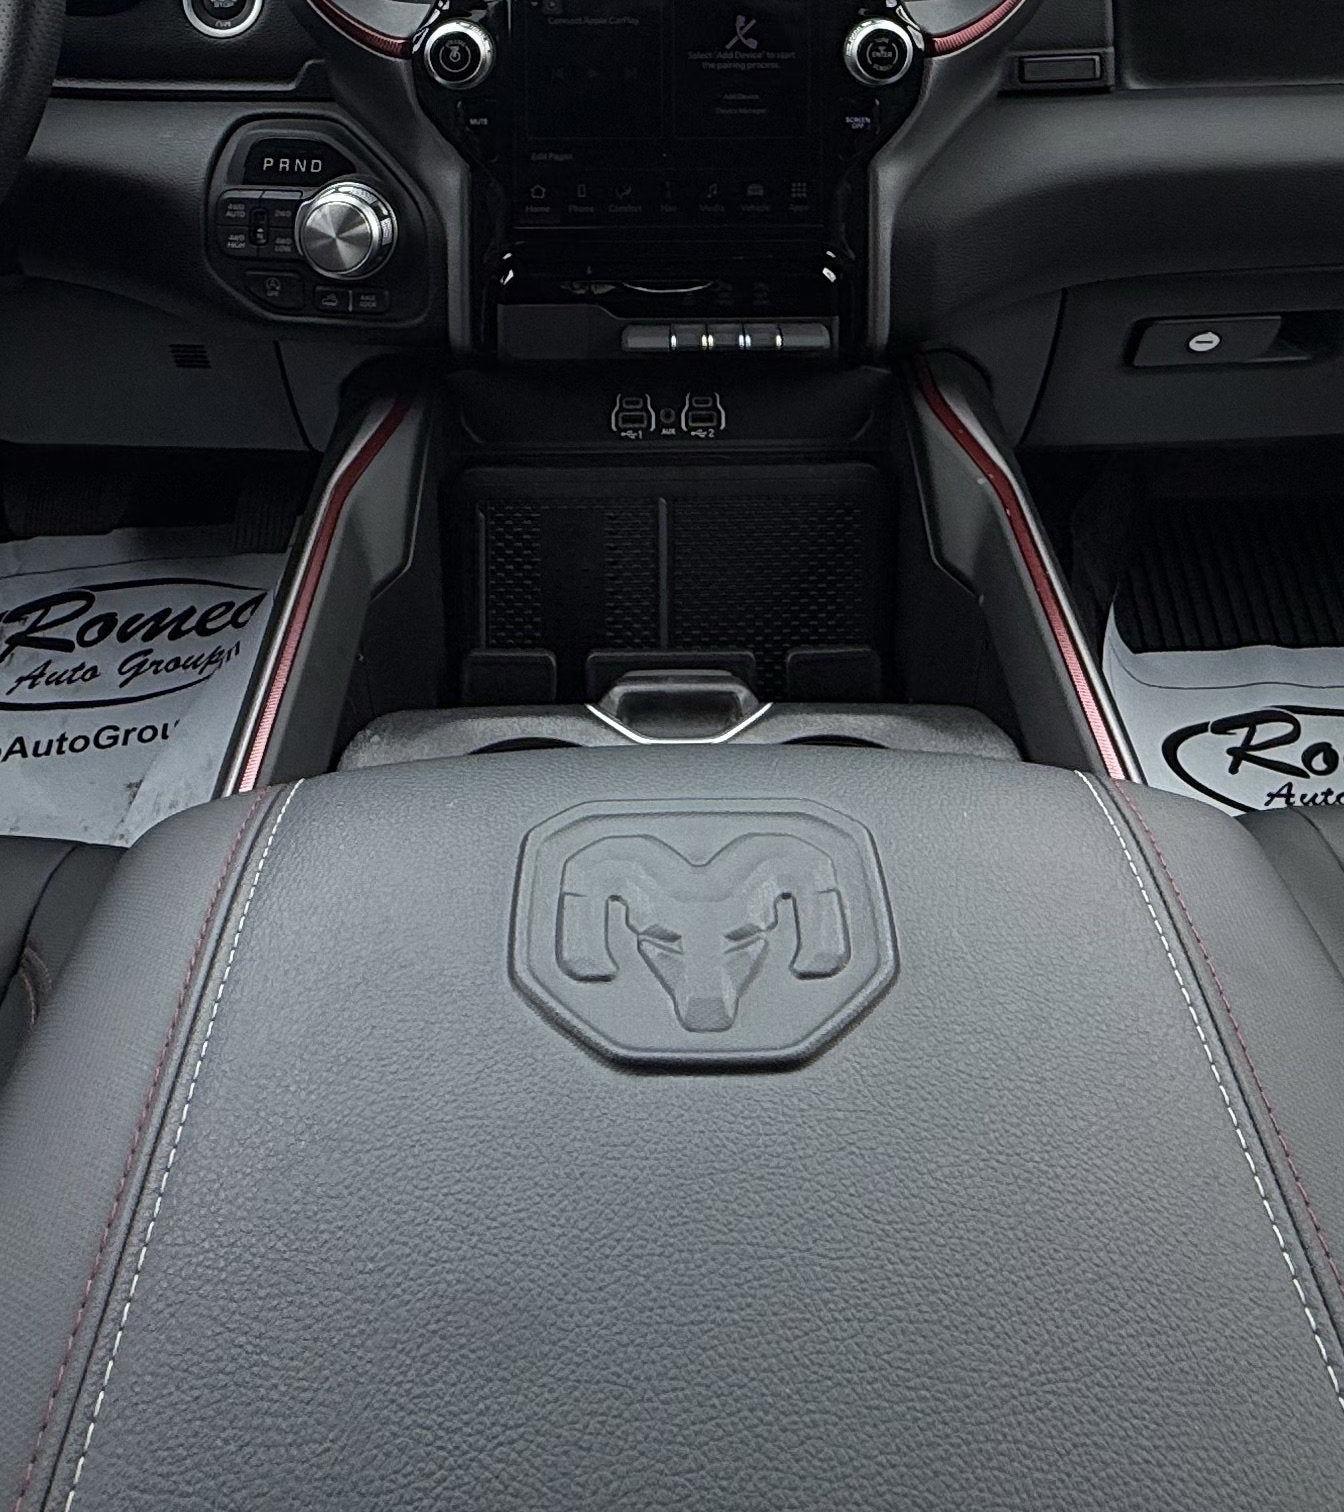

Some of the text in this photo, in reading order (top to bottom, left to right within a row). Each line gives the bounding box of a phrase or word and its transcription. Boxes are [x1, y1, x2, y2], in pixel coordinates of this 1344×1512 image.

[225, 210, 246, 219] AUTO
[661, 427, 676, 436] AUX
[6, 659, 102, 696] Auto
